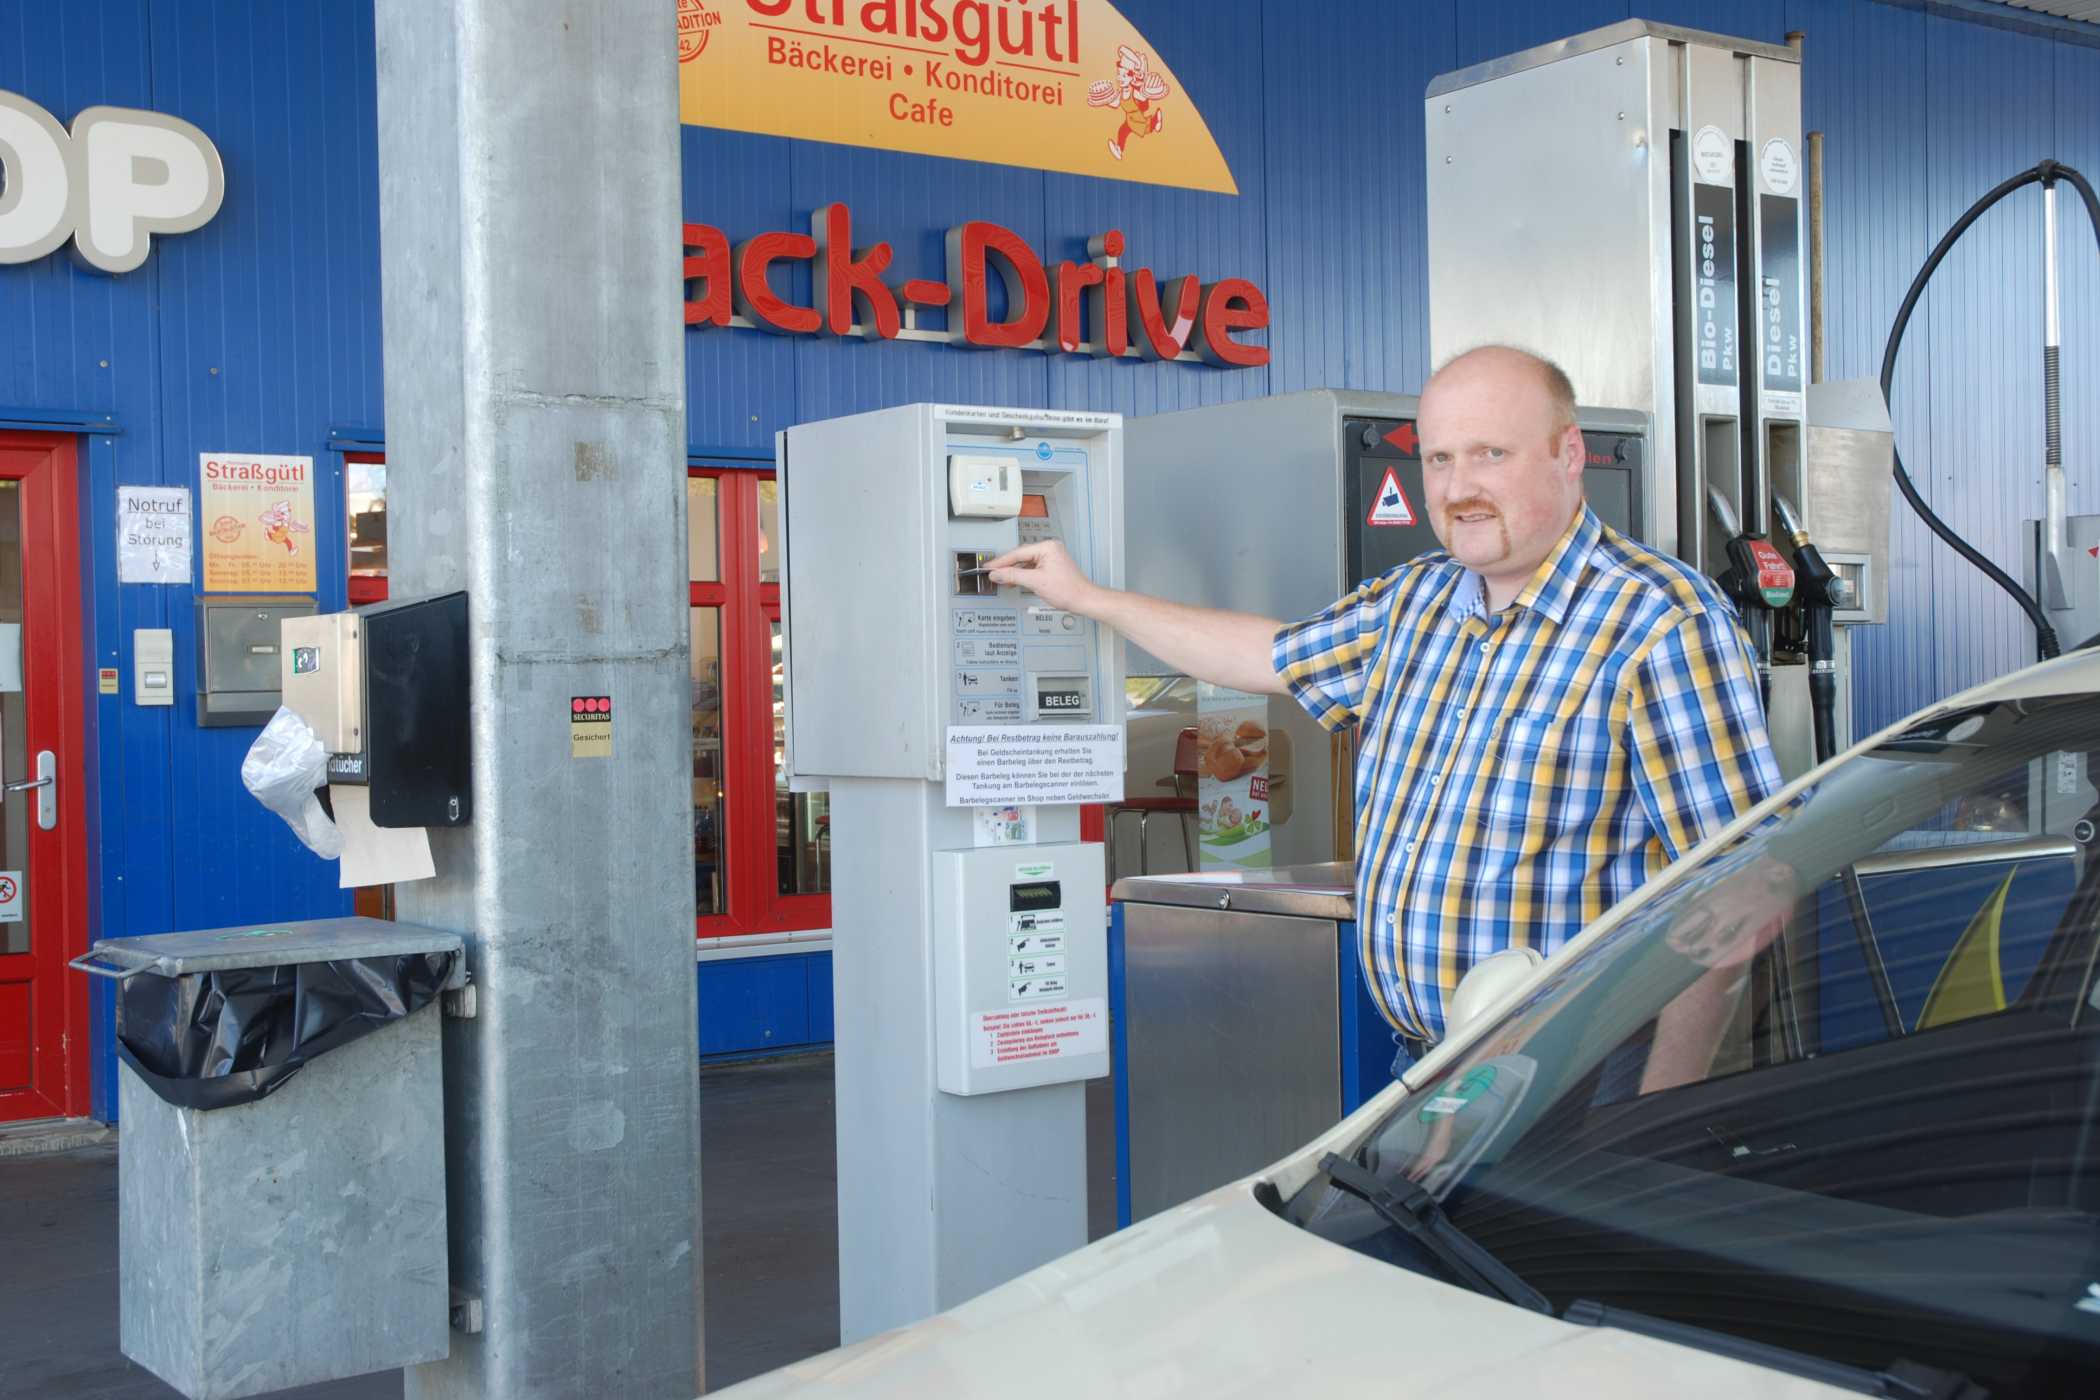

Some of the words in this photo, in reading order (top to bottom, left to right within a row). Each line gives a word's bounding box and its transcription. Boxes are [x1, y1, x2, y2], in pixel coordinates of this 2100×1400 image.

[748, 0, 1080, 66] aßgütl
[767, 36, 893, 81] Bäckerei
[925, 60, 1063, 106] Konditorei
[888, 92, 954, 126] Cafe
[1698, 215, 1717, 369] Bio-Diesel
[1765, 277, 1782, 376] Diesel
[1722, 327, 1733, 371] Pkw
[1787, 335, 1798, 377] Pkw
[206, 461, 304, 485] Straßgütl
[128, 497, 183, 513] Notruf
[145, 518, 167, 529] bei
[1045, 695, 1080, 706] BELEG
[573, 713, 610, 721] SECURITAS
[950, 734, 985, 744] Achtung!
[987, 734, 999, 743] Bei
[1001, 733, 1041, 744] Restbetrag
[1043, 733, 1062, 742] keine
[1063, 732, 1119, 743] Barauszahlung!
[977, 749, 988, 757] Bei
